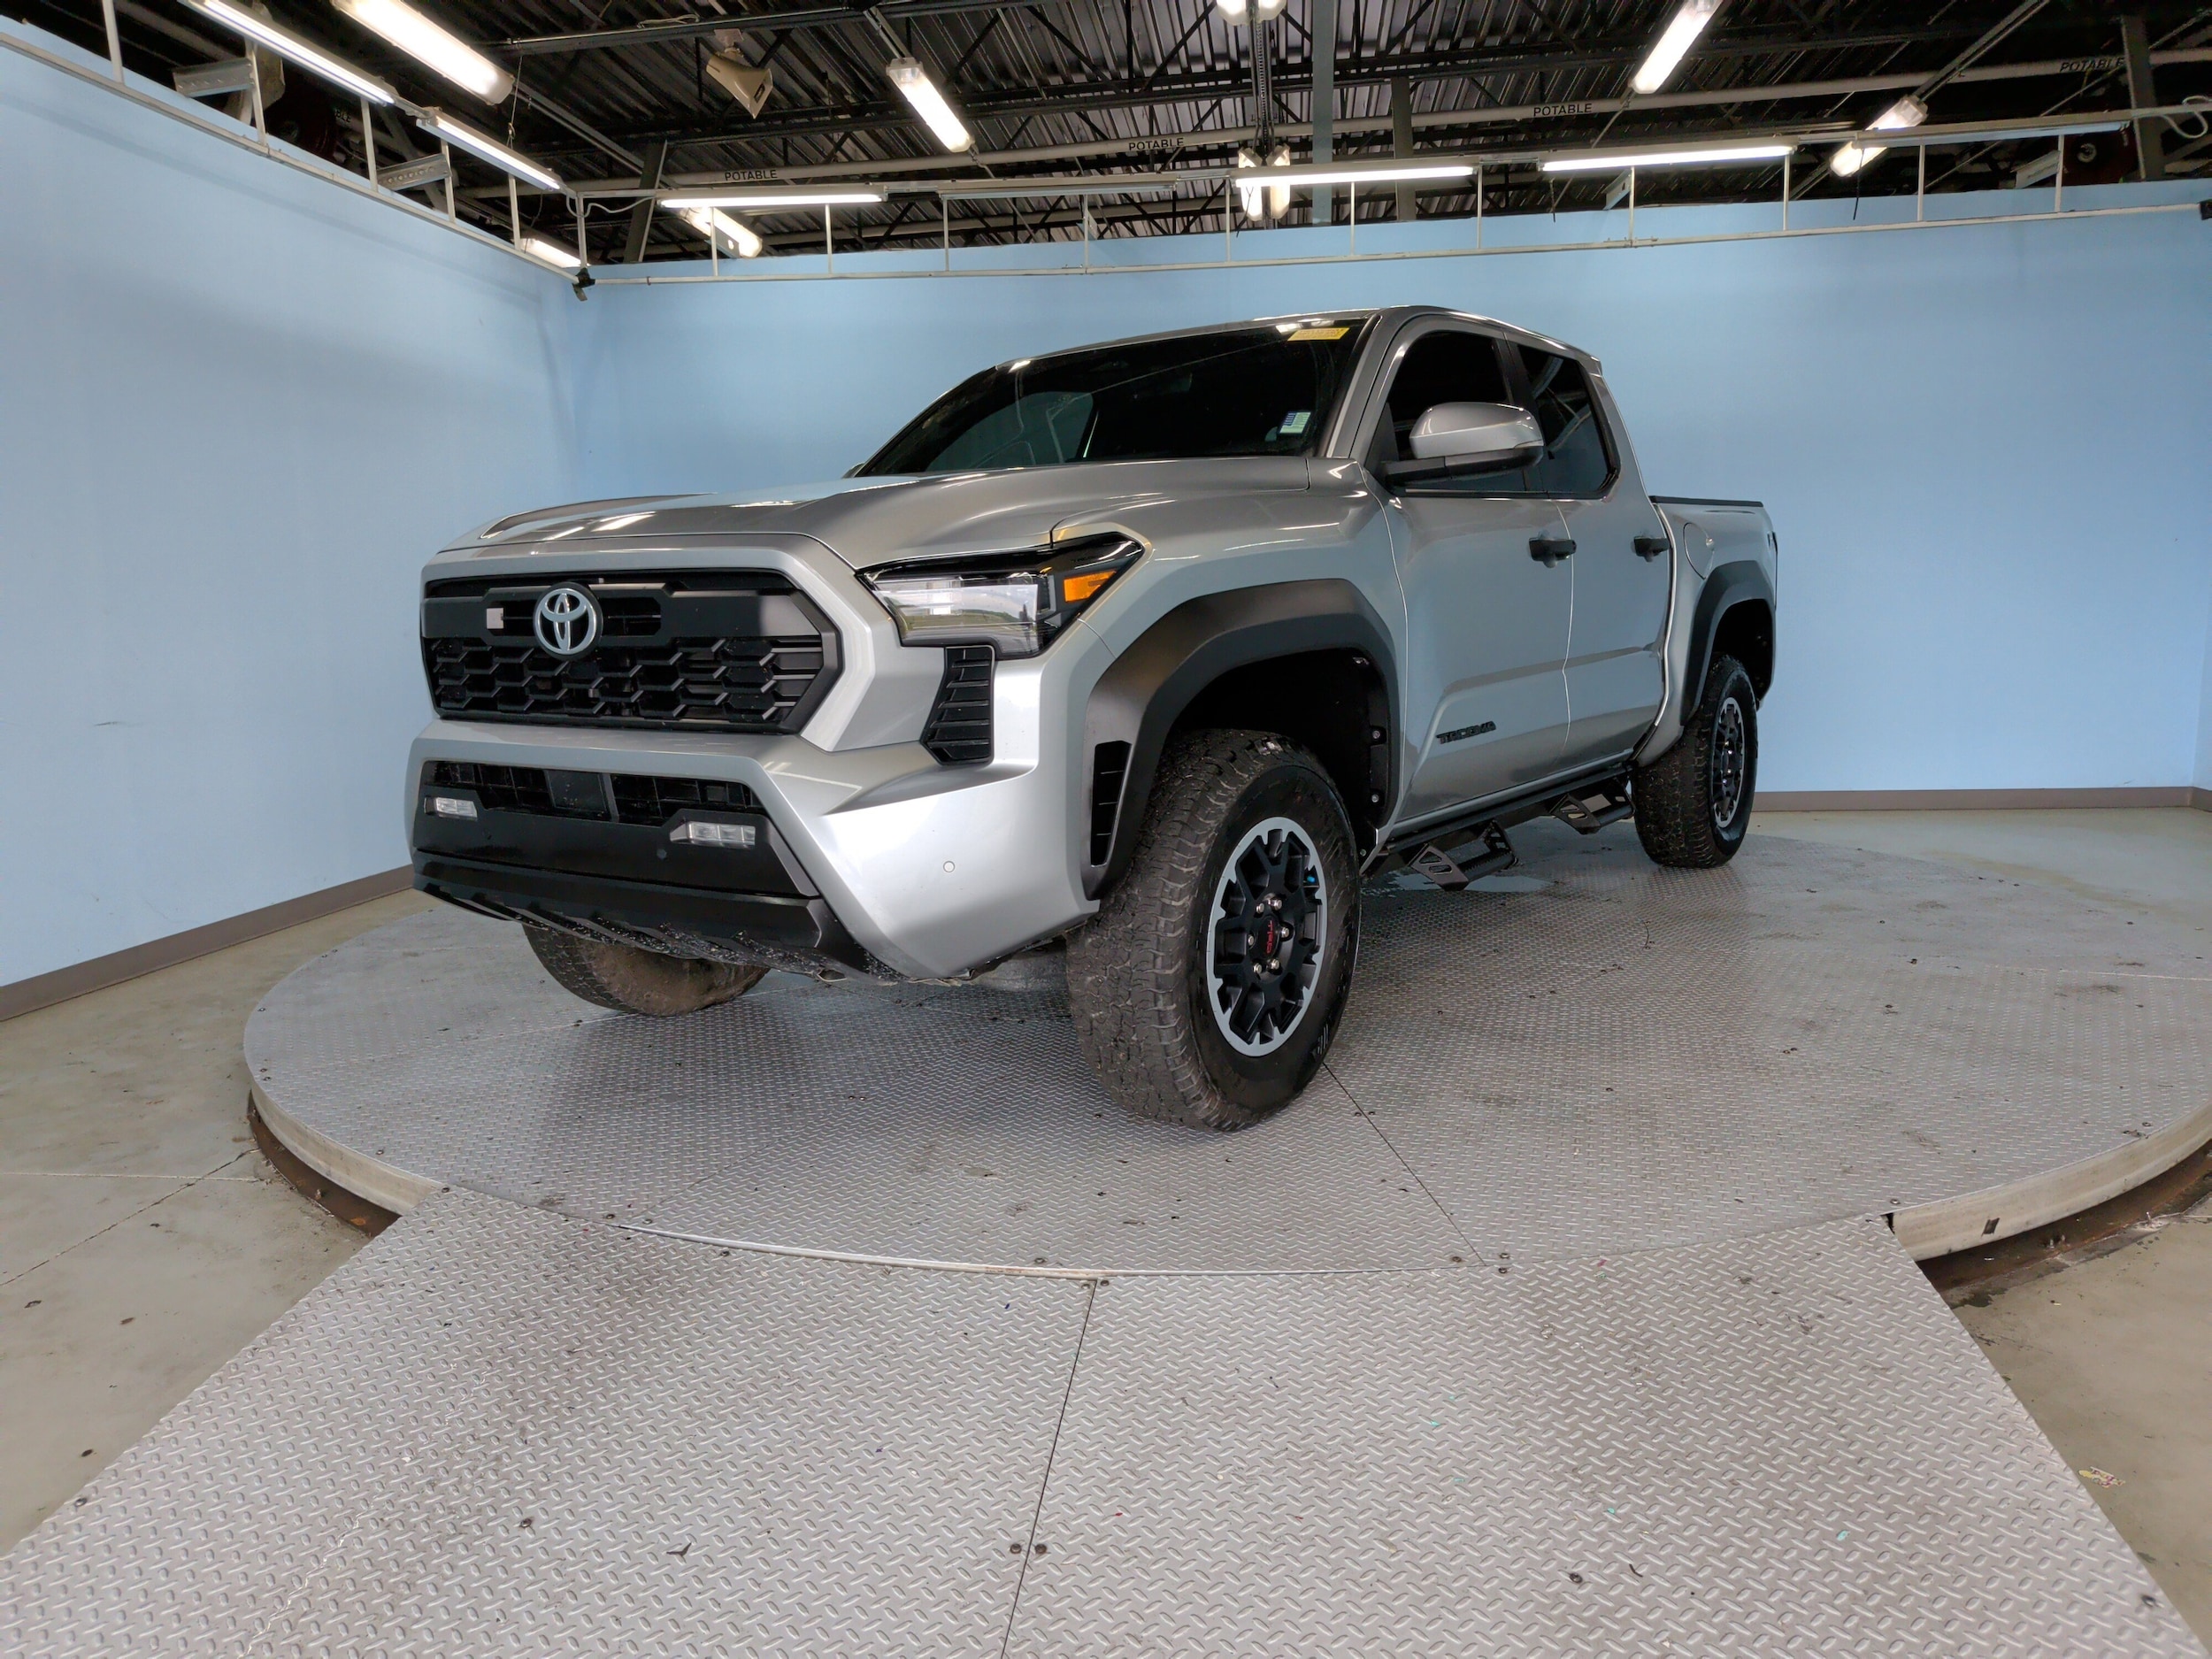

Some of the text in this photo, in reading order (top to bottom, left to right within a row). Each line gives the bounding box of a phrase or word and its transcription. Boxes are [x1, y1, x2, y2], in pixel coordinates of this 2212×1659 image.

[1533, 103, 1593, 117] POTABLE
[1128, 137, 1185, 151] POTABLE
[725, 169, 778, 181] POTABLE
